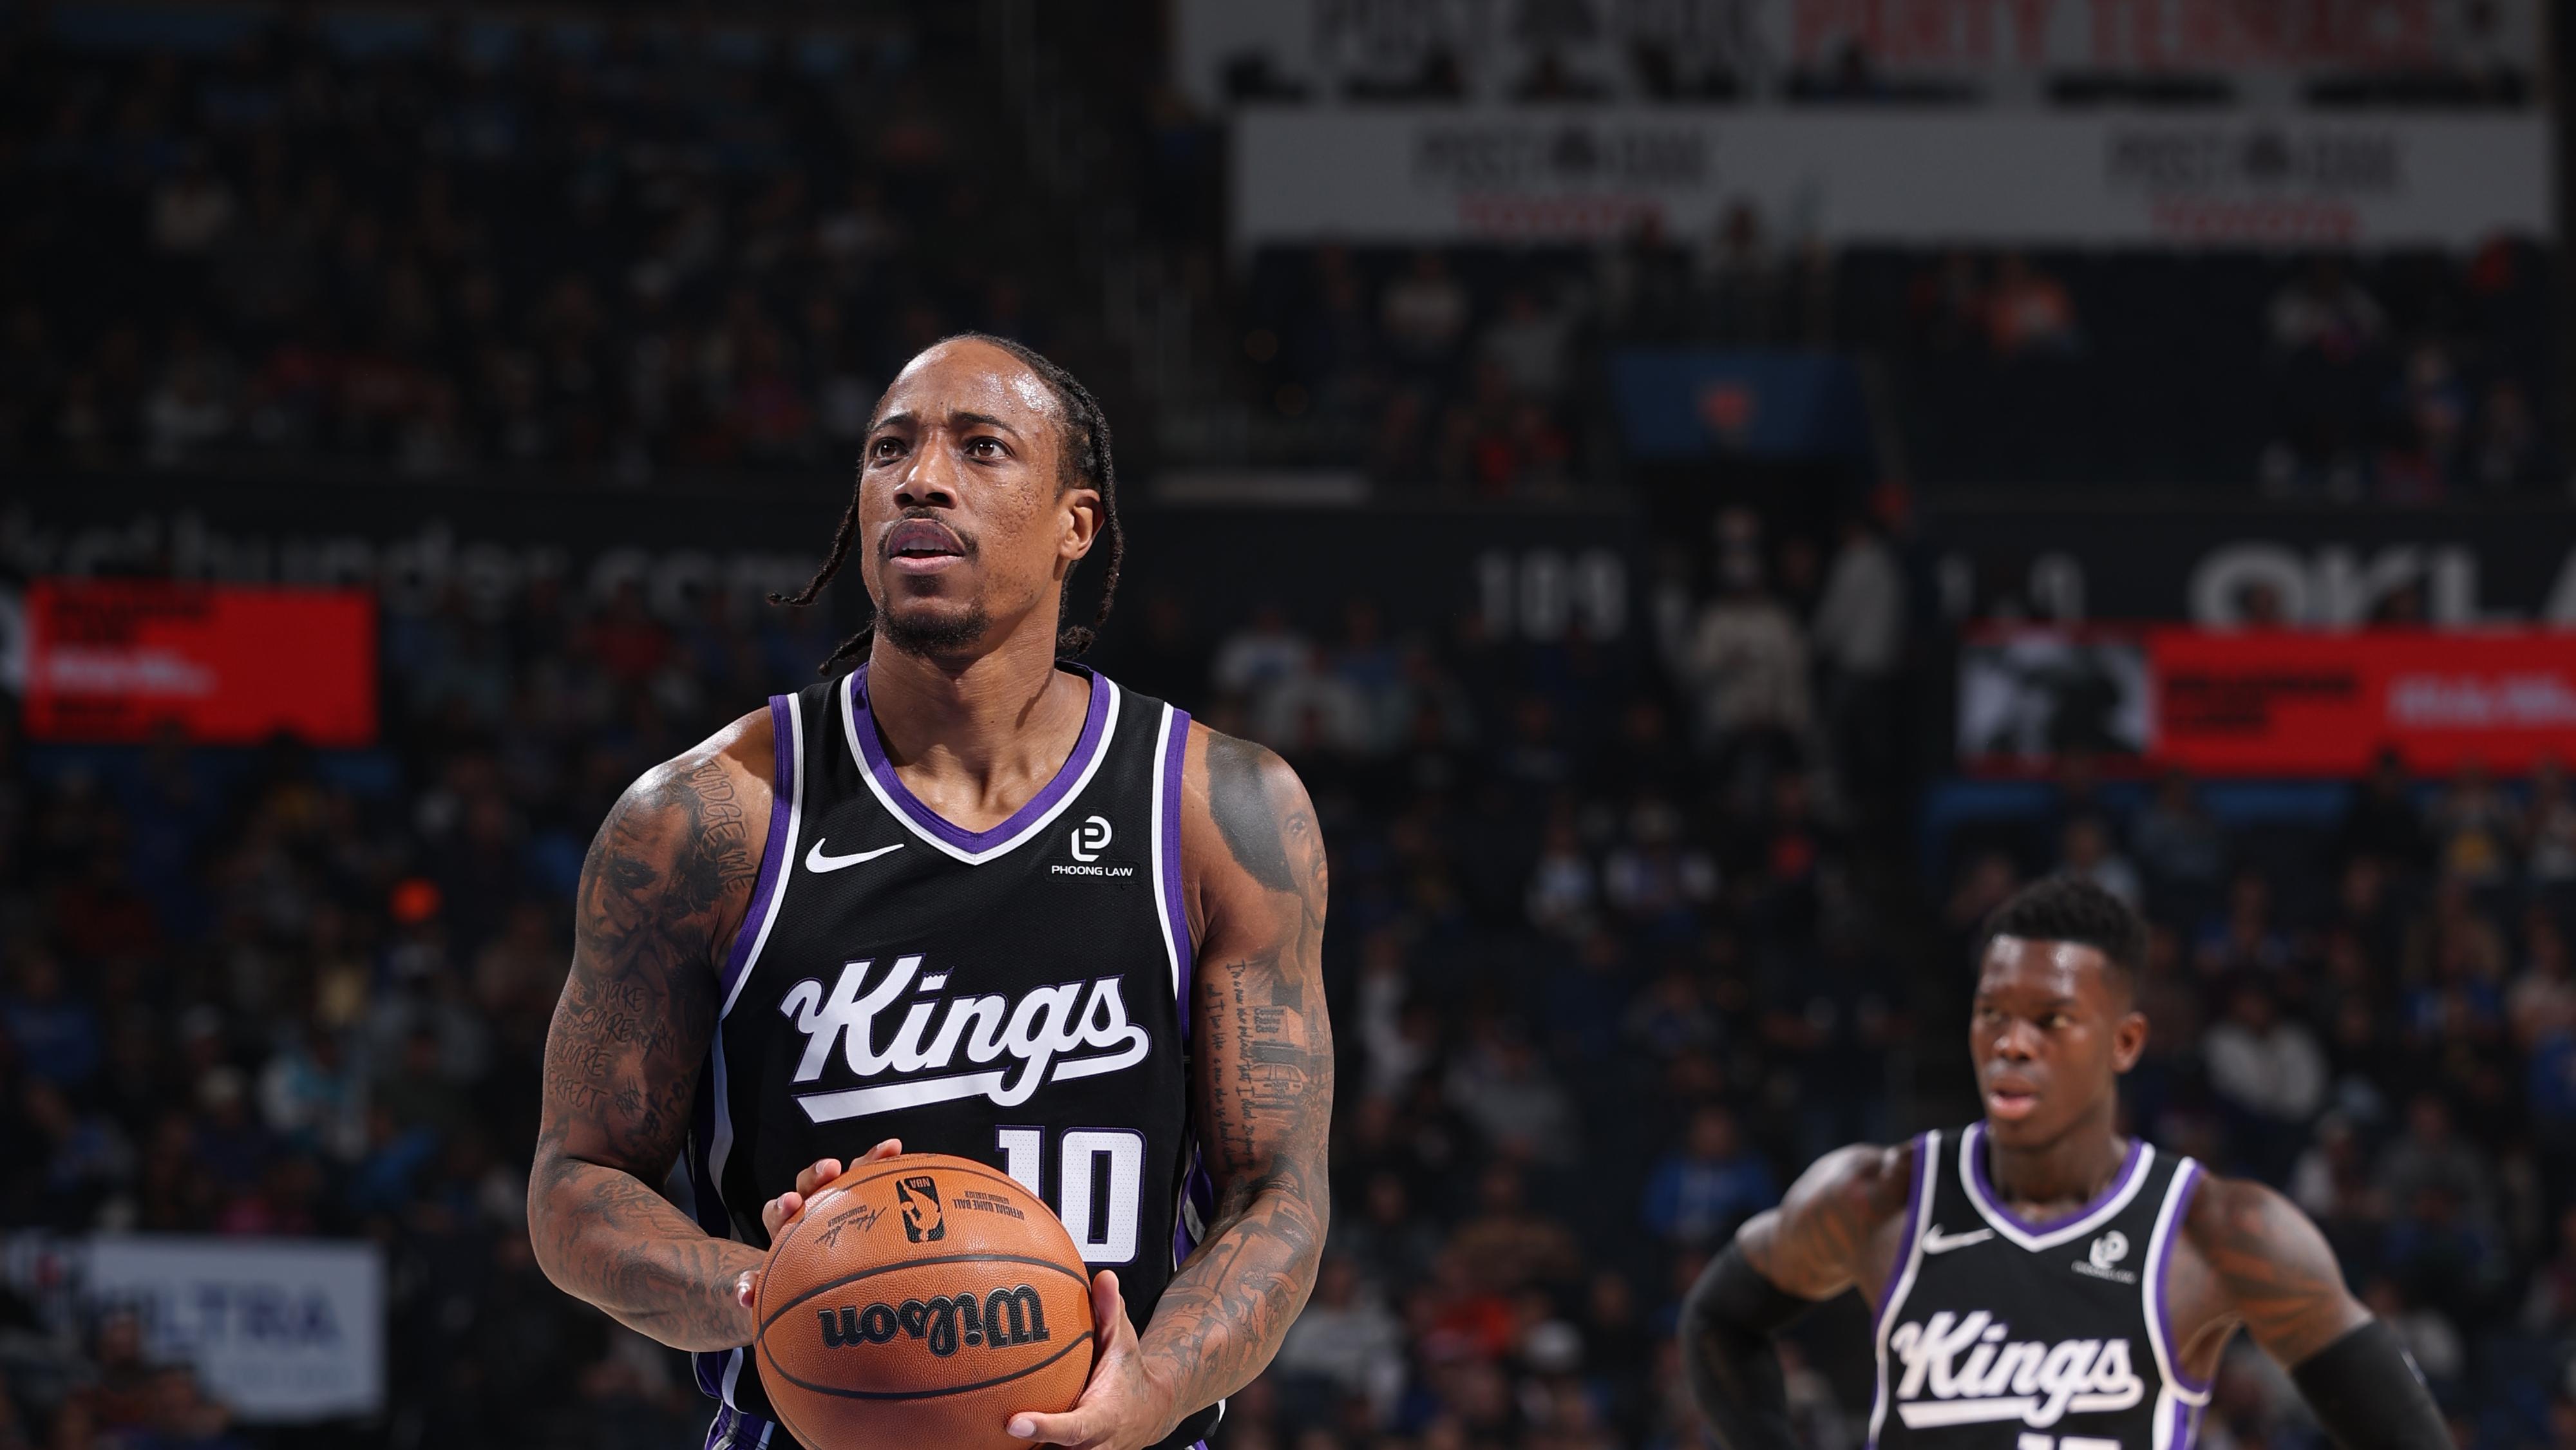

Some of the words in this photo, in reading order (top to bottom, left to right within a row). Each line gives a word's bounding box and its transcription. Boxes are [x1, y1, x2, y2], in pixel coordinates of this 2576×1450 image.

[1475, 546, 1628, 640] 109
[1051, 865, 1103, 876] PHOONG
[1105, 867, 1133, 876] LAW
[777, 954, 1152, 1125] Kings
[909, 1177, 931, 1189] NBA
[952, 1198, 972, 1209] BALL
[972, 1199, 994, 1212] GAME
[993, 1202, 1025, 1220] OFFICIAL
[828, 1205, 867, 1227] COMMISSIONER
[93, 1283, 344, 1343] LTRA
[819, 1285, 1050, 1357] Wilson
[1889, 1310, 2146, 1431] Kings
